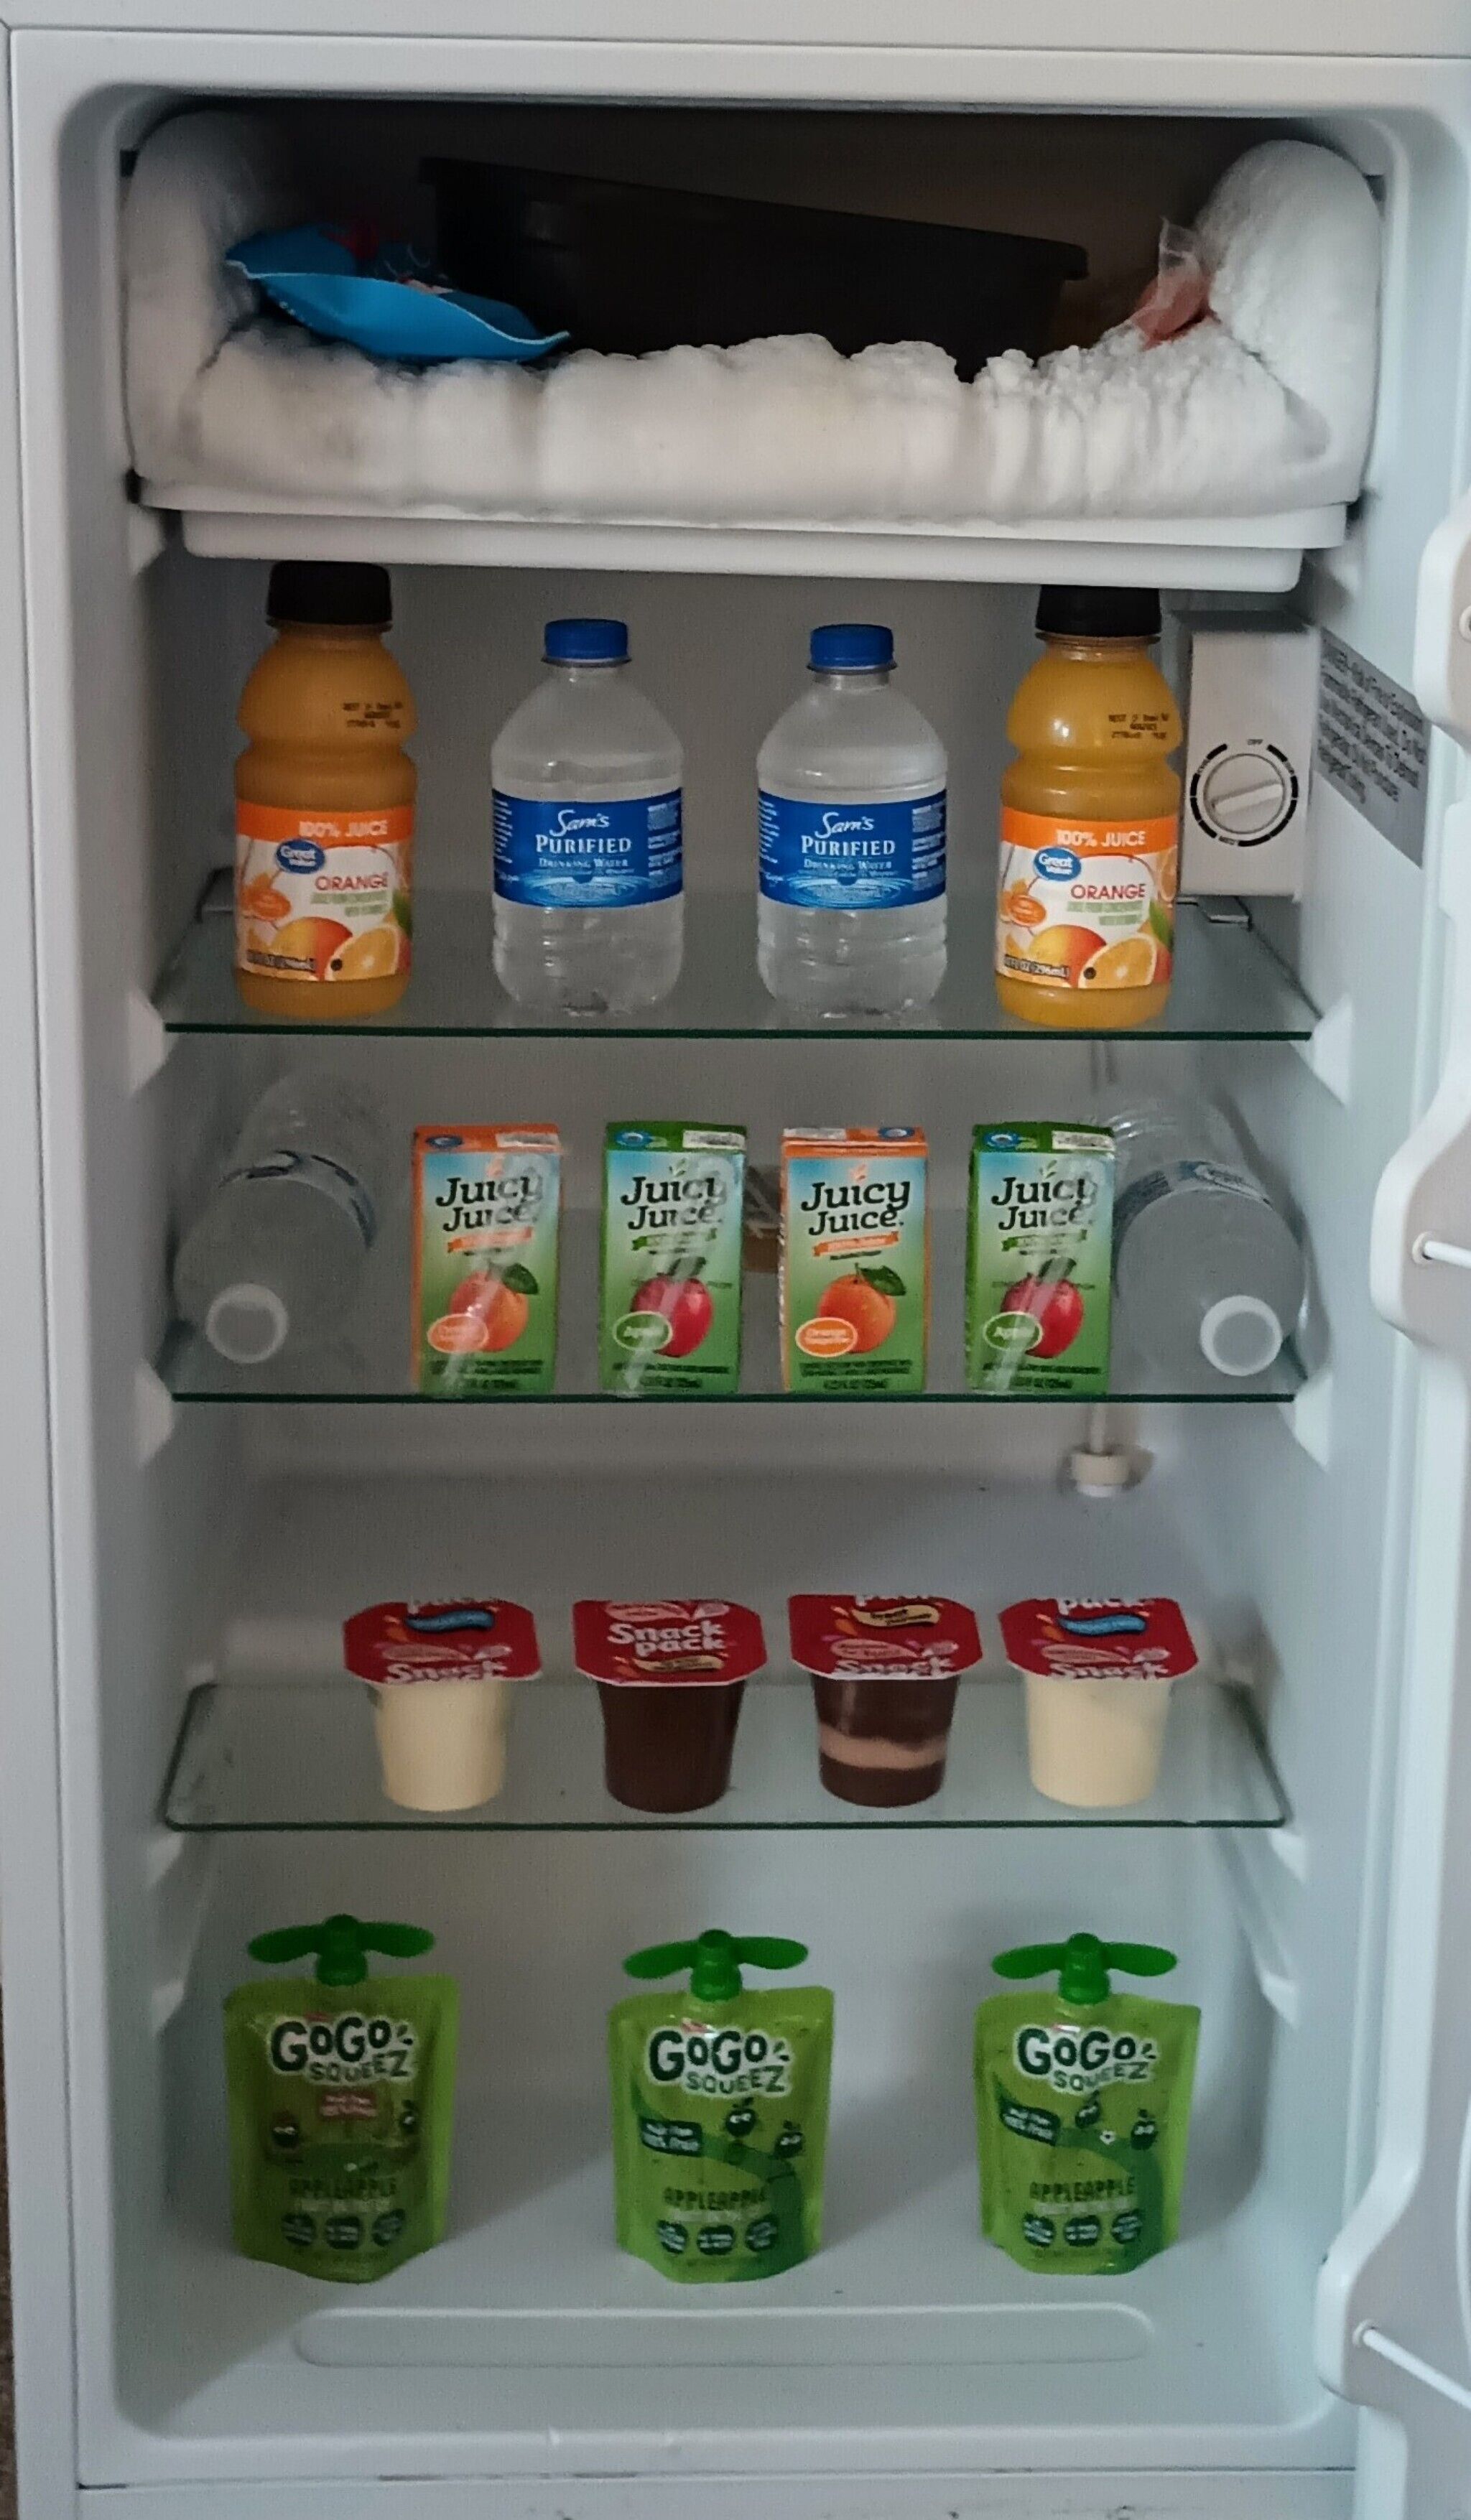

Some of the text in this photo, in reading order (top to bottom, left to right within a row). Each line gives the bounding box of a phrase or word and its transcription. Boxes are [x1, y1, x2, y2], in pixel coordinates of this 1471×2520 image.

[299, 819, 389, 839] 100% JUICE
[549, 809, 611, 837] Sam's
[815, 811, 875, 839] Sam's
[535, 834, 632, 854] PURIFIED
[801, 834, 896, 856] PURIFIED
[1055, 829, 1146, 847] 100% JUICE
[315, 873, 389, 891] ORANGE
[1070, 883, 1147, 900] ORANGE
[435, 1175, 544, 1207] Juicy
[620, 1175, 728, 1208] Juicy
[801, 1181, 911, 1212] Juicy
[991, 1175, 1098, 1207] Juicy
[442, 1201, 534, 1232] Juice
[627, 1202, 717, 1231] Juice
[808, 1206, 898, 1237] Juice
[998, 1202, 1087, 1232] Juice
[607, 1619, 727, 1645] Snack
